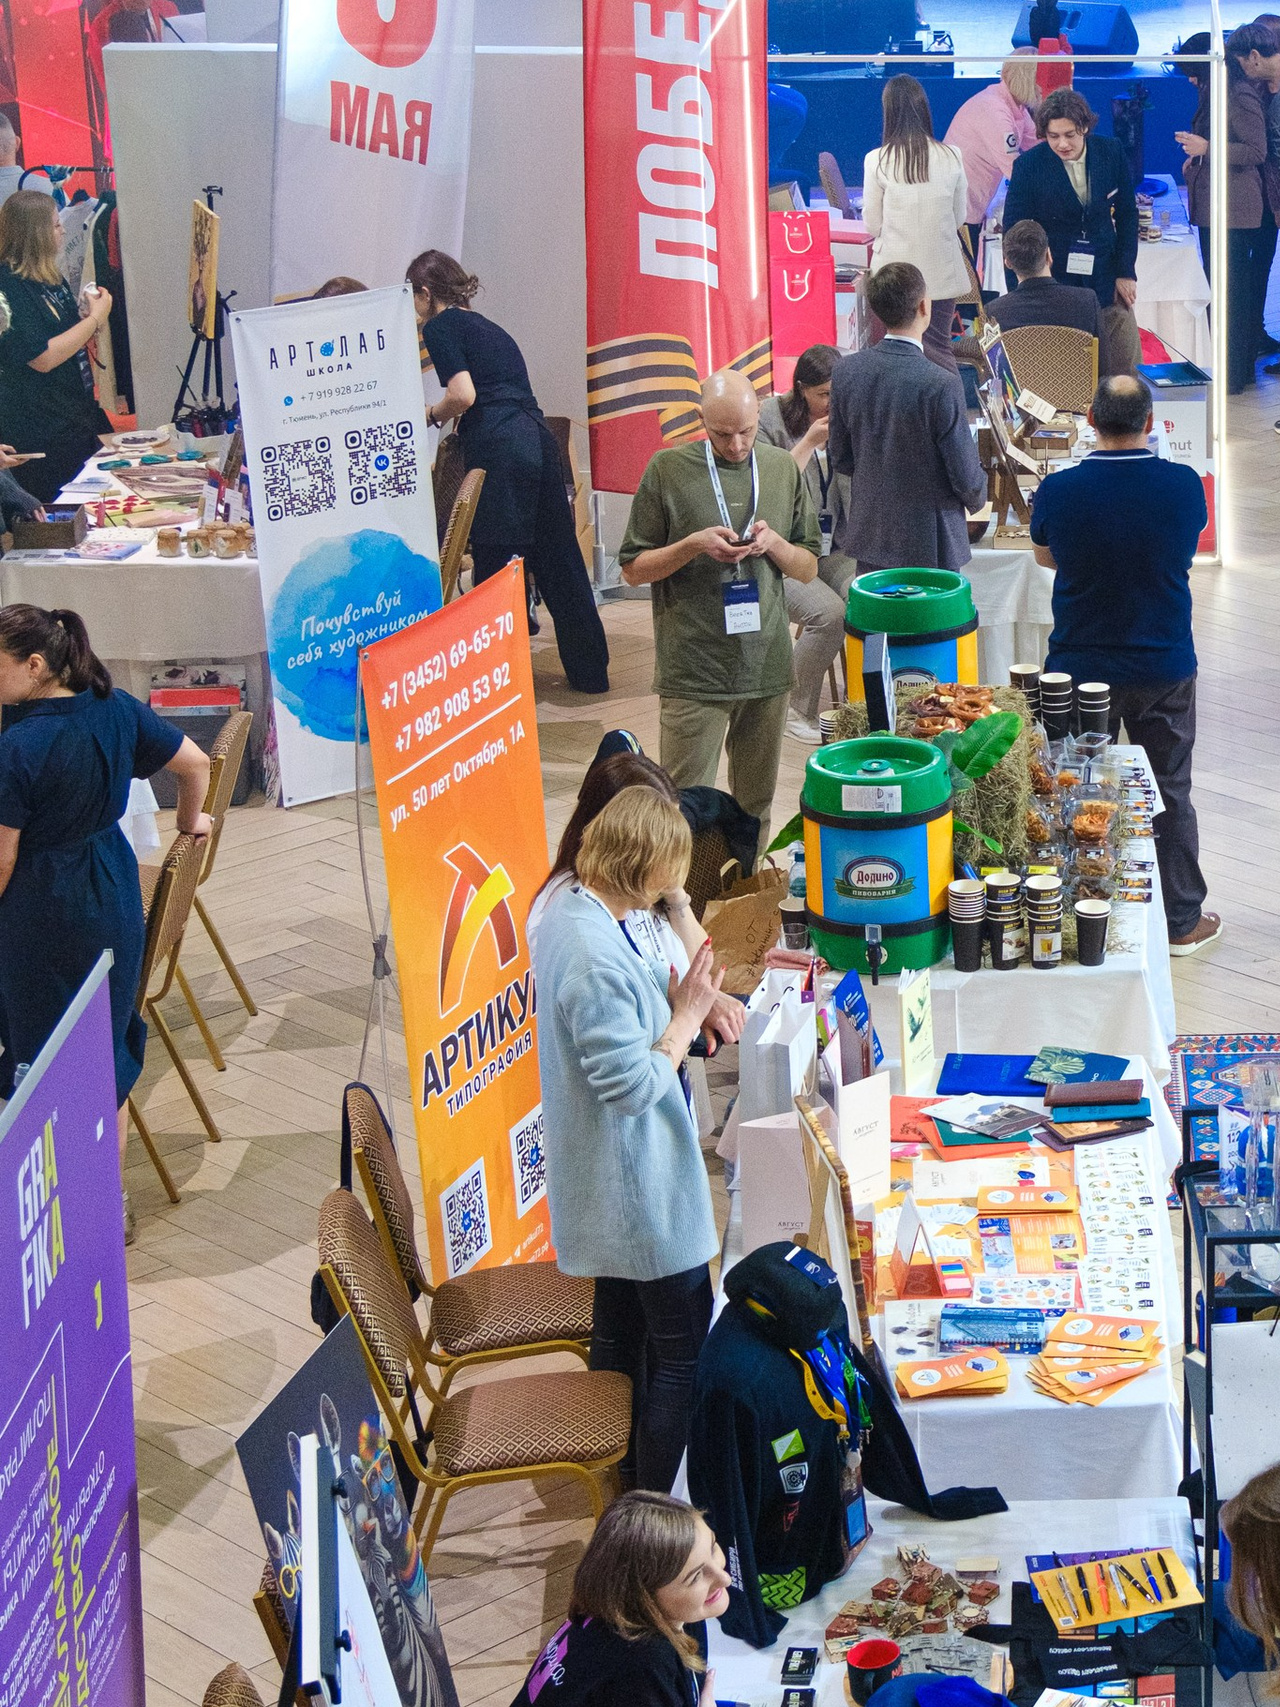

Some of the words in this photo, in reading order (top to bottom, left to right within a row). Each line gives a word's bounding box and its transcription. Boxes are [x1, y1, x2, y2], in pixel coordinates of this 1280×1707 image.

[330, 80, 432, 166] МАЯ
[634, 0, 727, 289] ПОБЕ
[306, 363, 352, 377] ШКОЛА
[316, 386, 333, 400] 919
[335, 384, 352, 397] 928
[354, 382, 365, 393] 22
[366, 380, 378, 391] 67
[289, 412, 318, 425] Тюмень,
[330, 403, 371, 417] Республики
[287, 642, 323, 669] себя
[329, 609, 429, 658] художником
[301, 590, 401, 641] Почувствуй
[382, 681, 397, 709] +7
[402, 651, 447, 704] (3452)
[450, 611, 514, 668] 69-65-70
[395, 723, 412, 752] +7
[415, 705, 442, 742] 982
[444, 687, 470, 722] 908
[473, 675, 491, 704] 53
[493, 662, 511, 691] 92
[390, 804, 410, 832] ул.
[413, 785, 428, 812] 50
[430, 772, 451, 801] лет
[453, 740, 508, 783] Октября,
[509, 719, 525, 746] 1А
[852, 889, 897, 897] ПИВОВАРНЯ
[857, 870, 894, 884] Додино
[446, 1029, 532, 1117] ТИПОГРАФИЯ
[853, 1121, 879, 1136] АВГУСТ
[18, 1118, 58, 1241] GRA
[21, 1195, 65, 1330] FIKA
[3, 1488, 49, 1592] МАГНИТЫ
[21, 1525, 51, 1601] КЕПКИ
[88, 1552, 127, 1649] ФУТБОЛКИ
[23, 1613, 50, 1673] БИЗНЕСА
